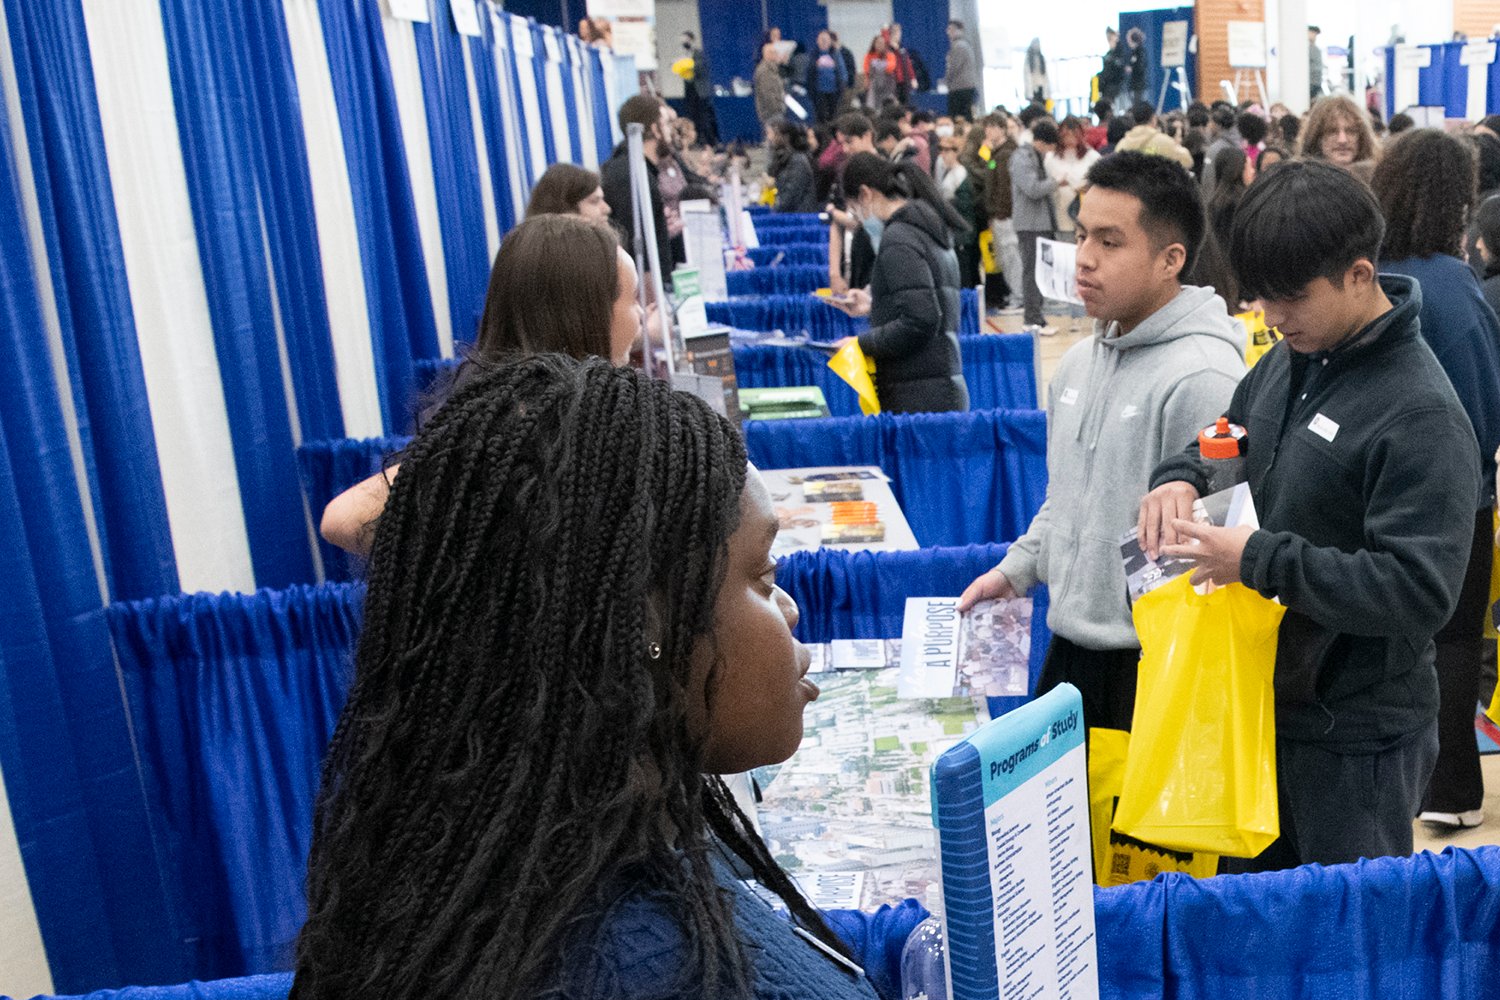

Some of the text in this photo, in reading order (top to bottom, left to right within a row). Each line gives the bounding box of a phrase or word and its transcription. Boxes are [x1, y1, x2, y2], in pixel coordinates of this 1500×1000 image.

[923, 600, 956, 668] A PURPOSE
[990, 710, 1079, 780] Programs of Study
